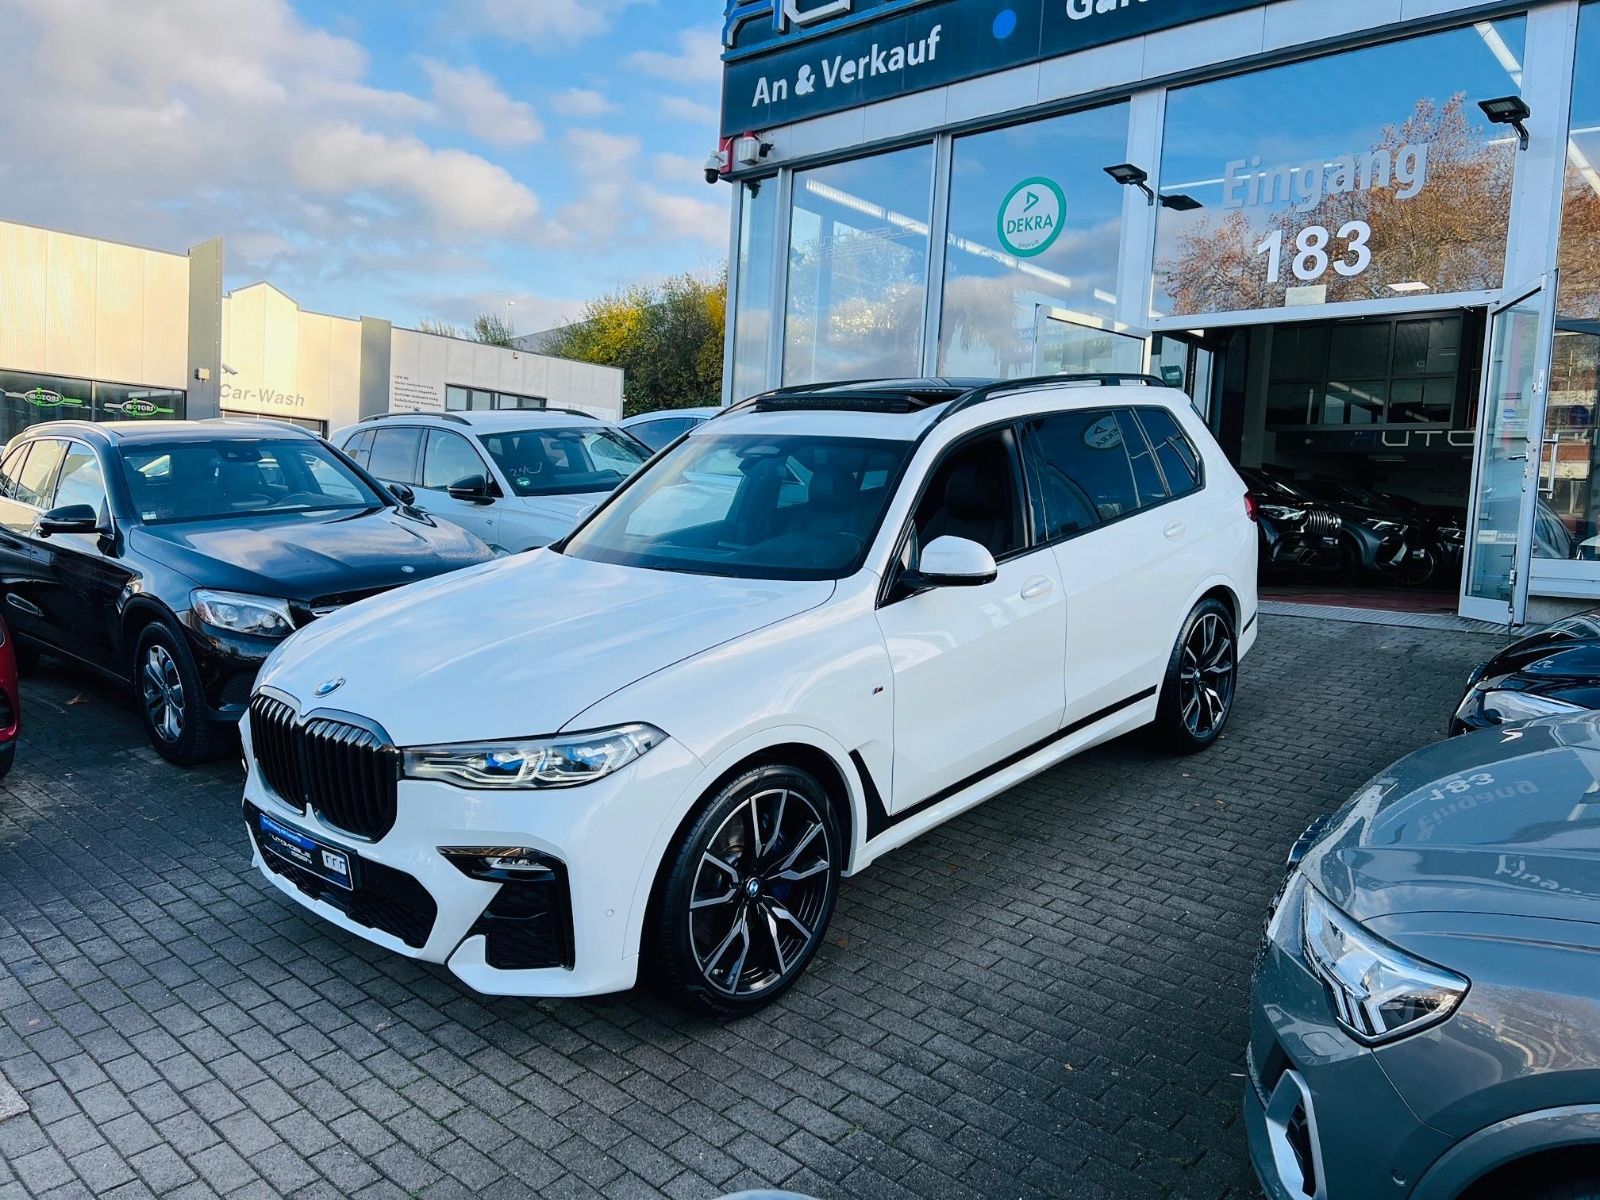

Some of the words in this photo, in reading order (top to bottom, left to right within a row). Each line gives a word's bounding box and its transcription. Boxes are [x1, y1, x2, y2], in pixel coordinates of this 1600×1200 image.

[752, 77, 787, 107] An
[795, 64, 816, 95] &
[822, 24, 942, 88] Verkauf
[1222, 142, 1429, 213] Eingang
[1007, 213, 1053, 235] DEKRA
[1257, 220, 1371, 283] 183
[220, 384, 305, 407] Car-Wash
